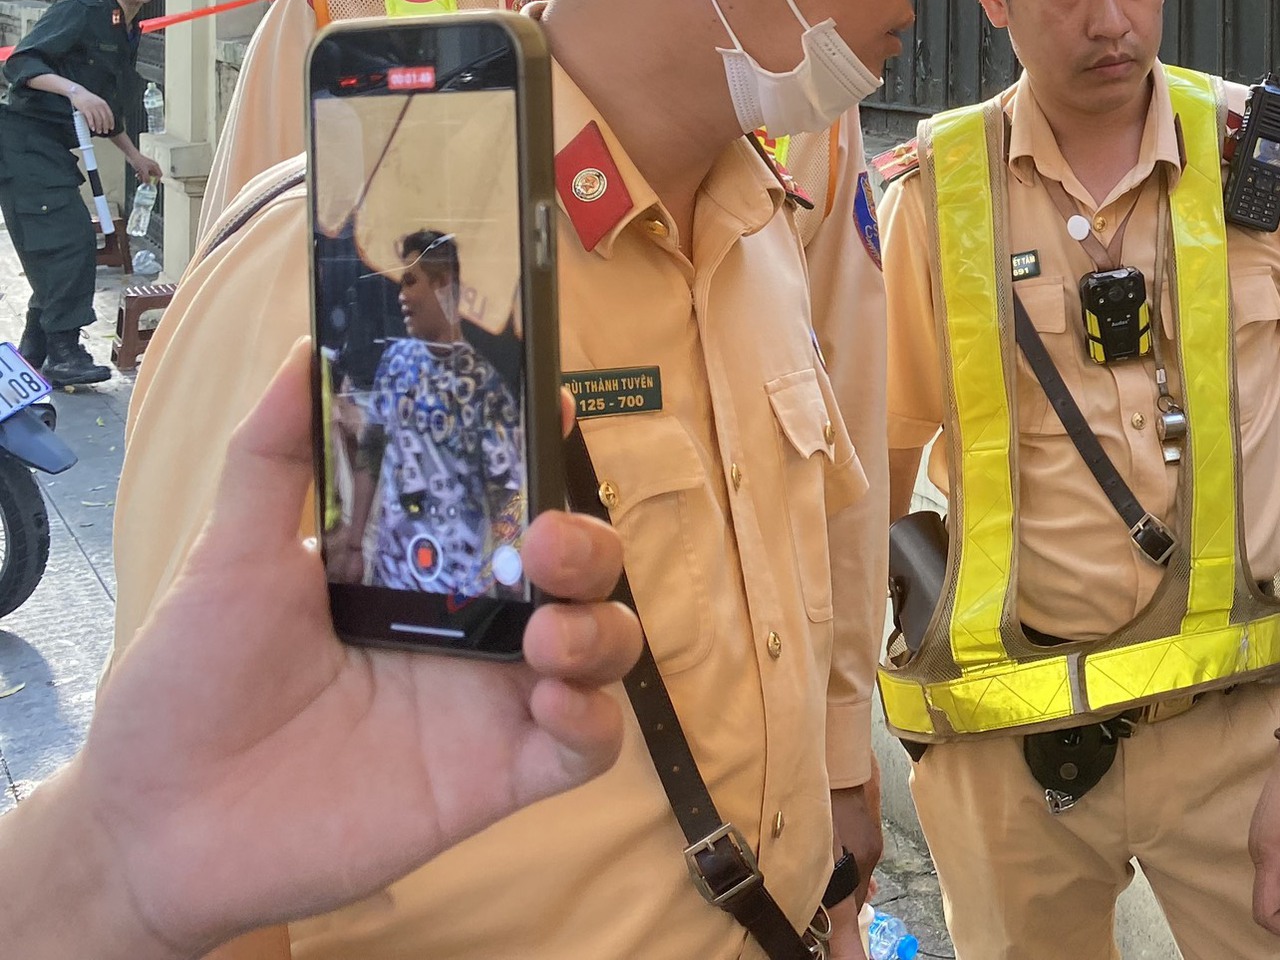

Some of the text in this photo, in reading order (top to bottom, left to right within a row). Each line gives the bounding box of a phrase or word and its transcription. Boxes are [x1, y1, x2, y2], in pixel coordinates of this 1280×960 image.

[1013, 256, 1021, 267] ẾT
[0, 371, 42, 414] 1.08
[585, 378, 618, 393] THÀNH
[580, 398, 605, 412] 125
[617, 395, 644, 408] 700
